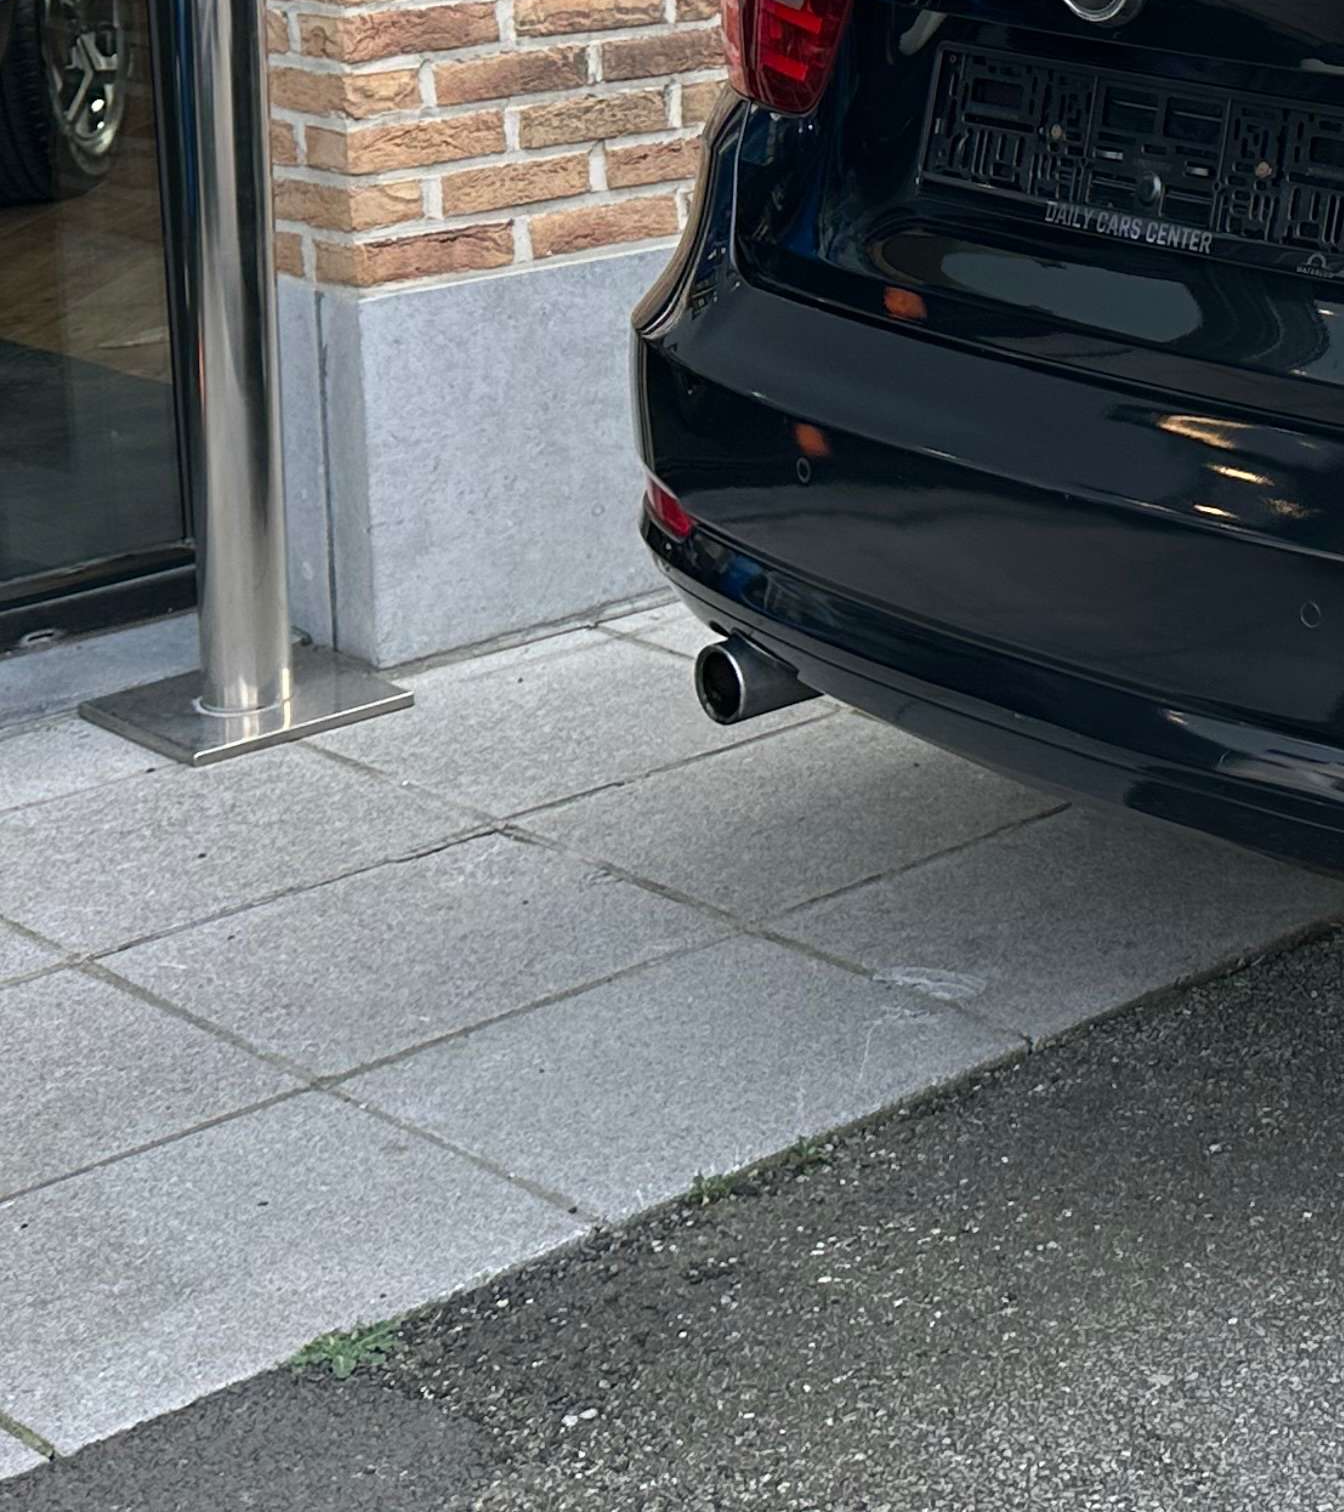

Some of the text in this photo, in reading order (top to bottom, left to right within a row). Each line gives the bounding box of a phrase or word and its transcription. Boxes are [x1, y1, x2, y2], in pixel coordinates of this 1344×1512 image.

[1044, 200, 1213, 254] DAILY CARS CENTER
